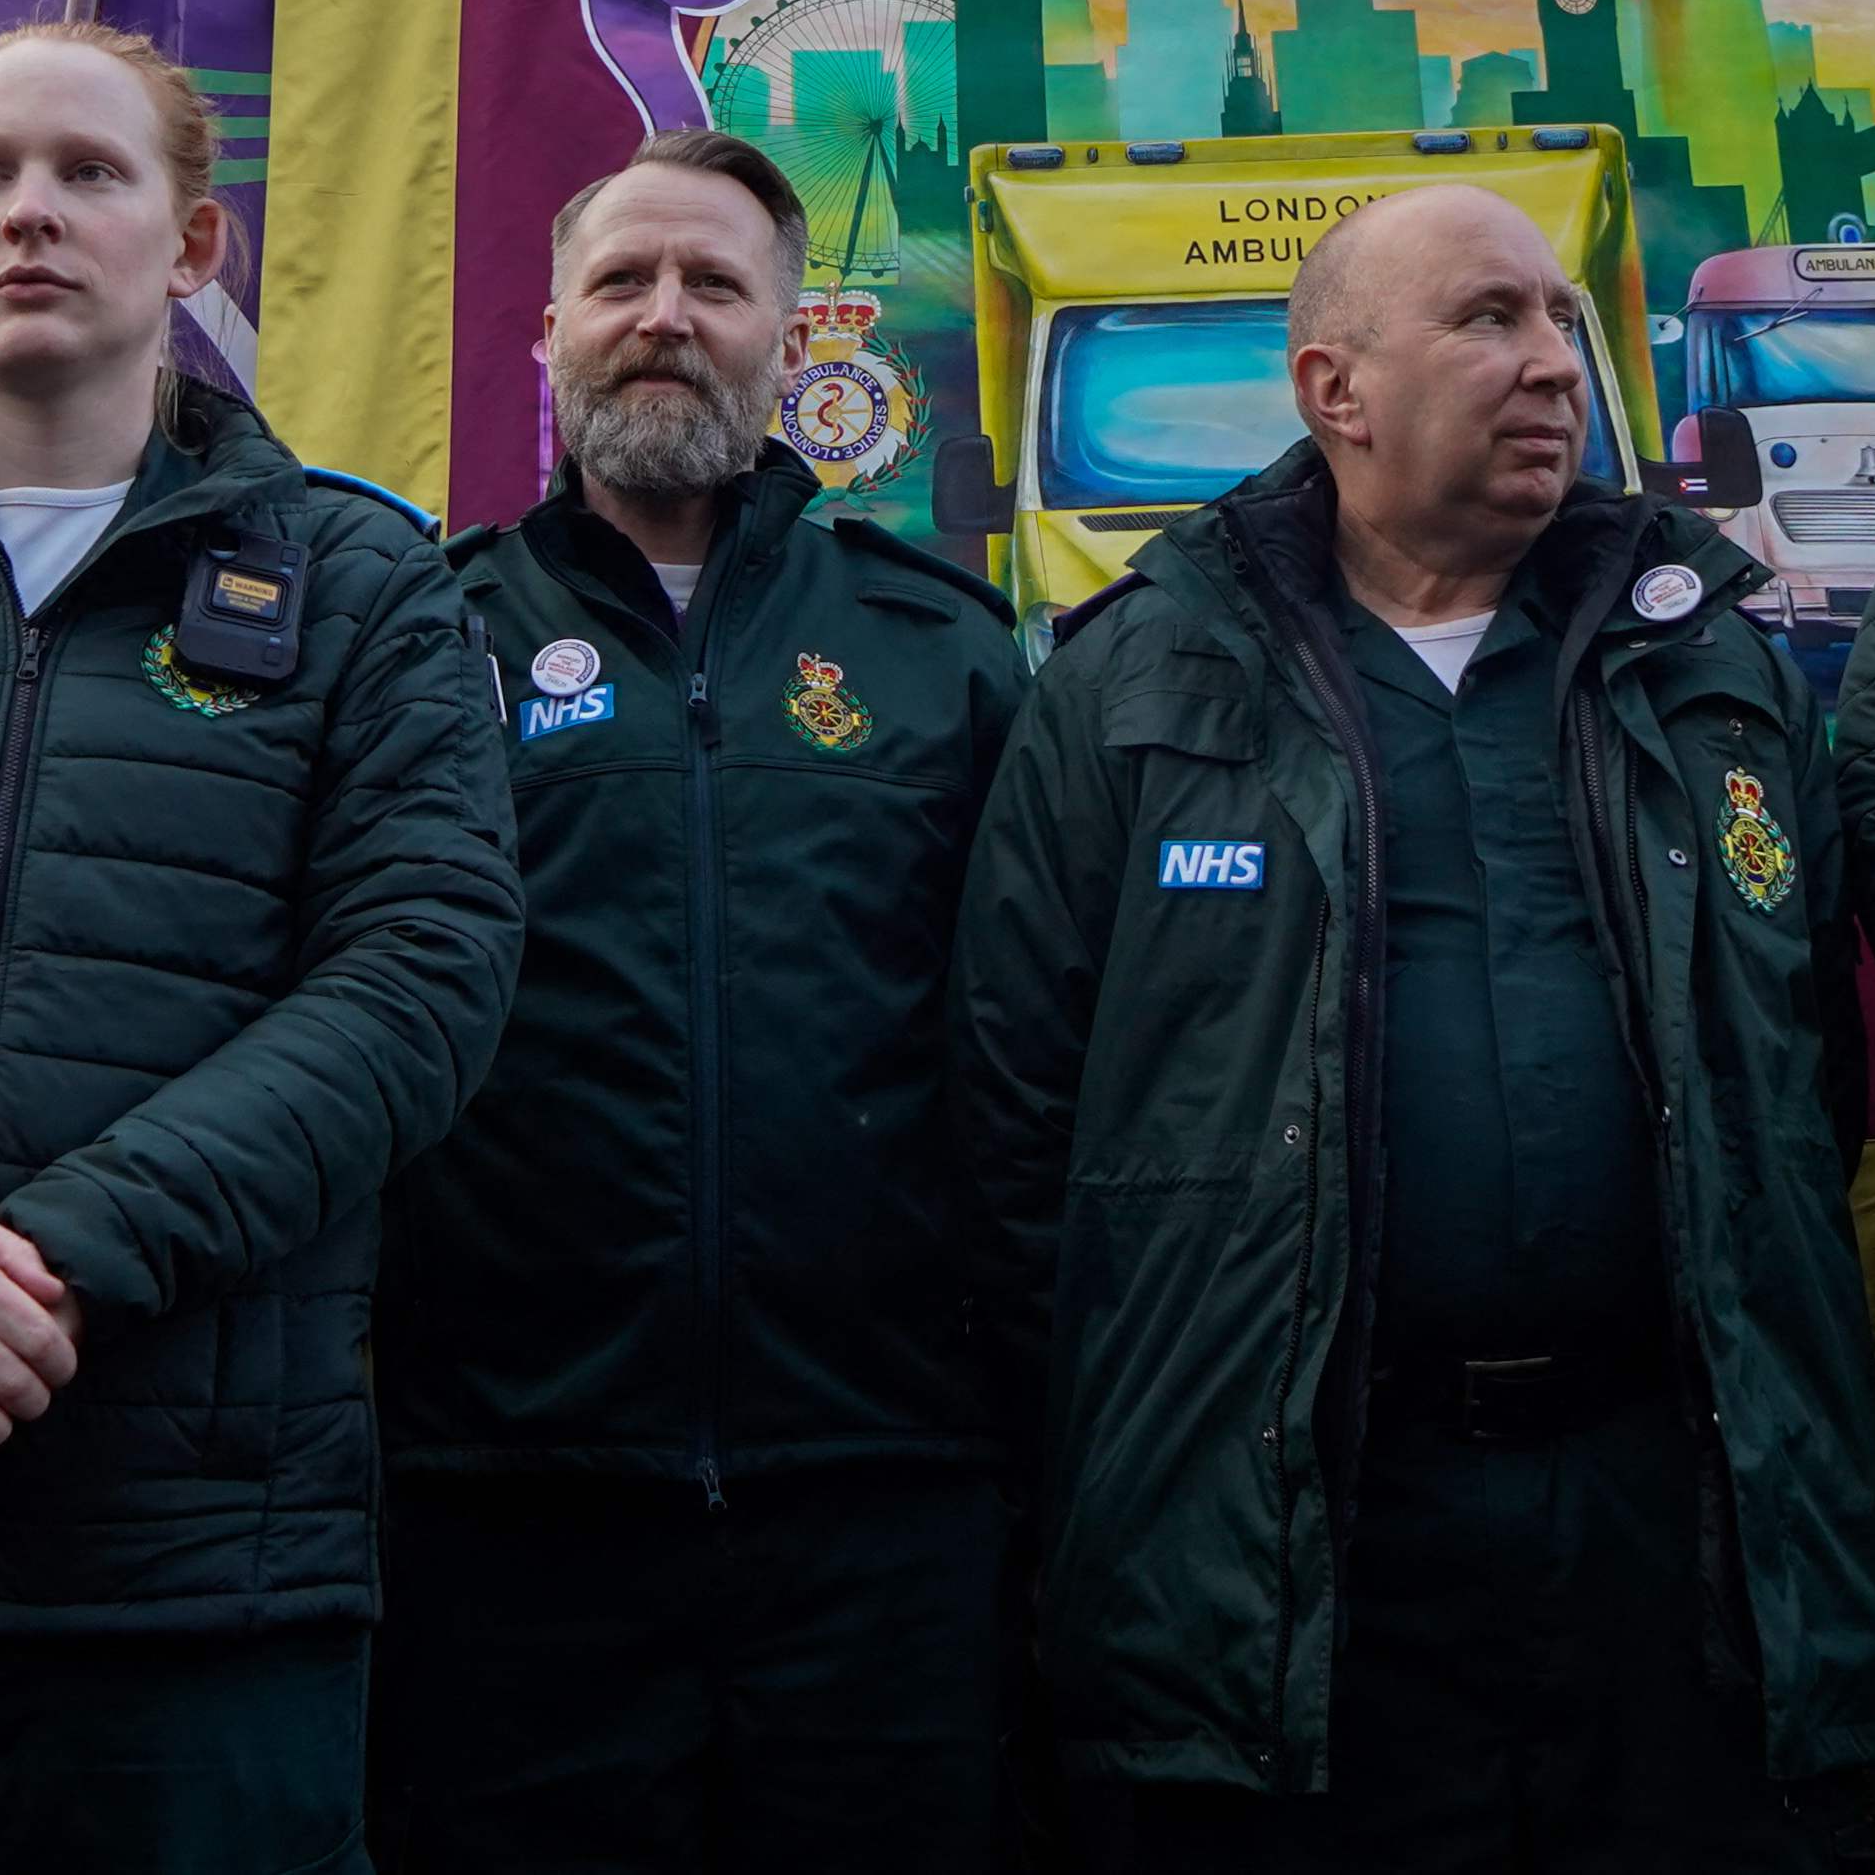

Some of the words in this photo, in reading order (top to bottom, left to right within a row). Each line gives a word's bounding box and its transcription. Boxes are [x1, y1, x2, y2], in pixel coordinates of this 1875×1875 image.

[1219, 194, 1386, 224] LONDO
[792, 363, 877, 398] AMBULANCE
[782, 410, 830, 455] LONDON
[844, 404, 888, 454] SERVICE
[529, 687, 607, 735] NHS
[1162, 844, 1262, 885] NHS
